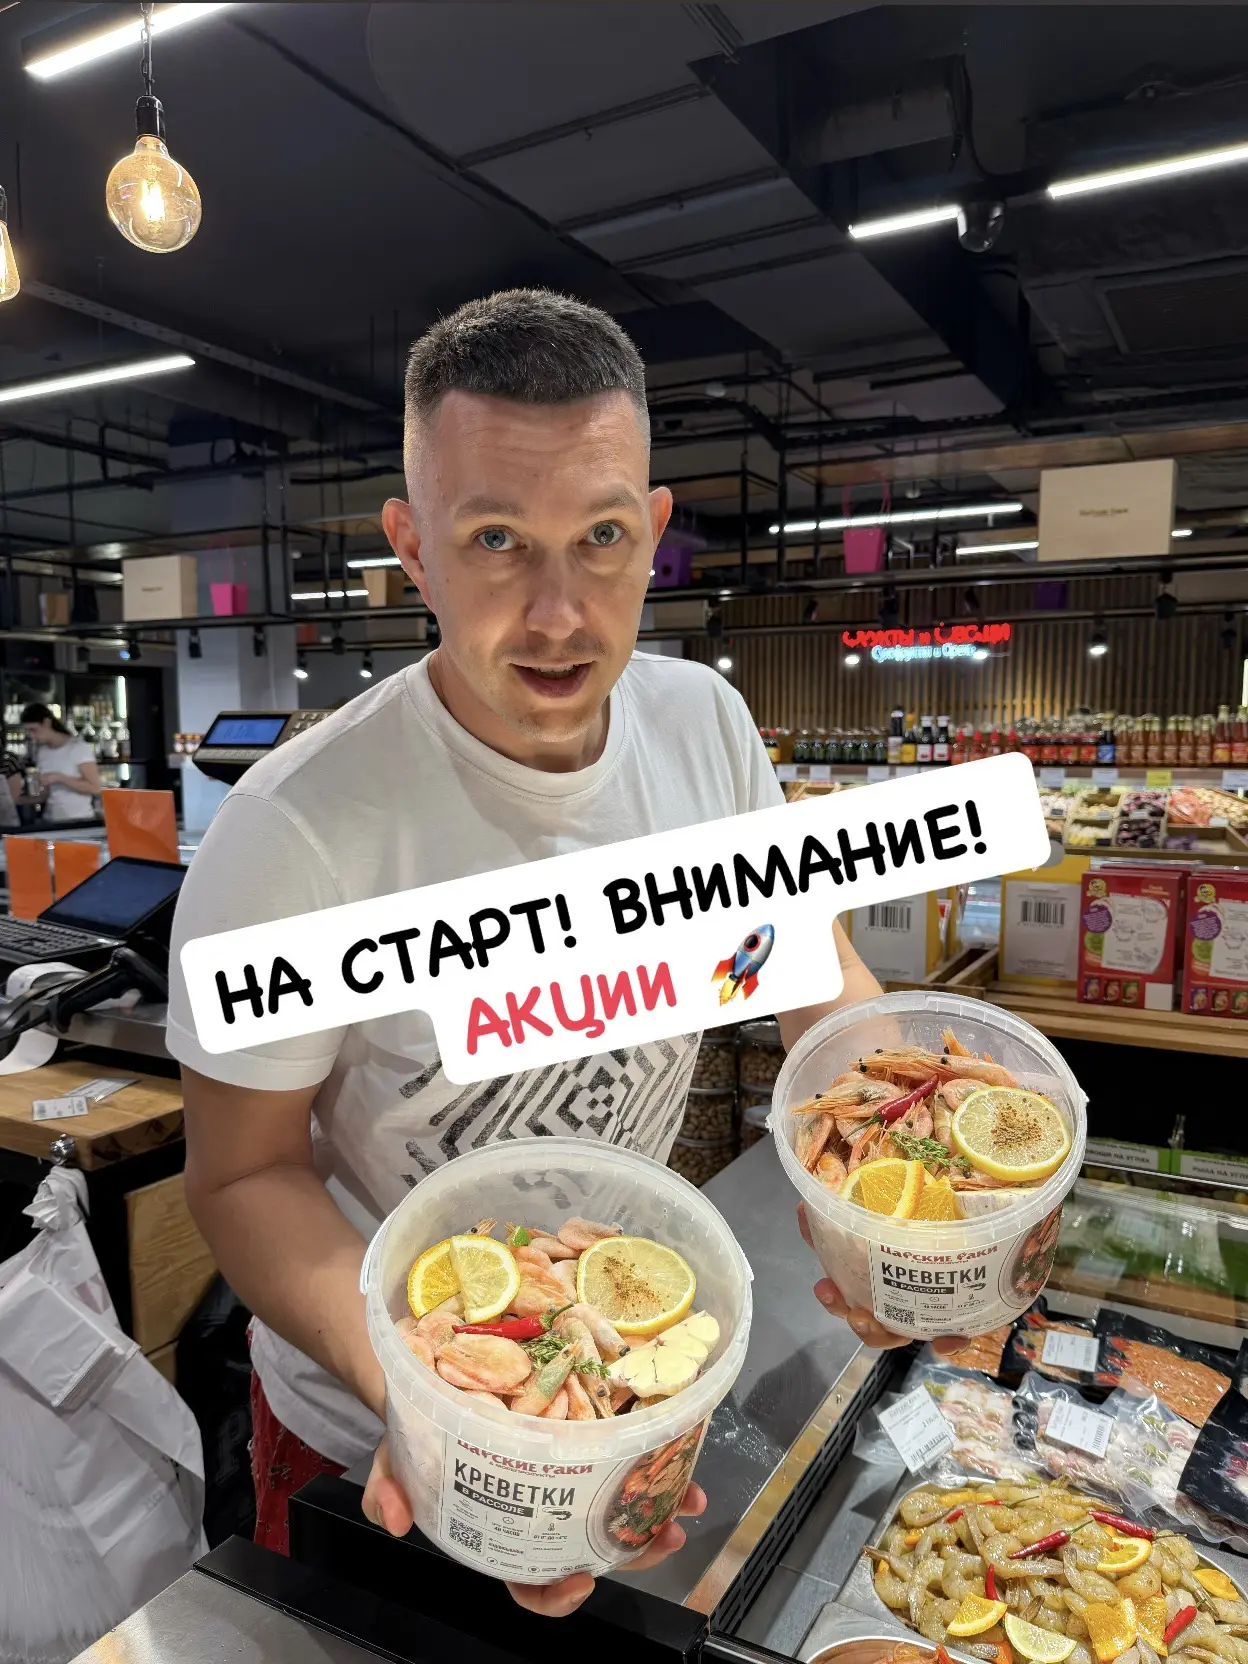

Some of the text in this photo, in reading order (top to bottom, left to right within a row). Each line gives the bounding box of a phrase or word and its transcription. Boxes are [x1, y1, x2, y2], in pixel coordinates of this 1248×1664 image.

[881, 1261, 987, 1285] КРЕВЕТКИ
[900, 1283, 948, 1294] РАССОЛЕ
[454, 1457, 576, 1506] КРЕВЕТКИ
[462, 1486, 469, 1495] В
[472, 1491, 525, 1515] РАССОЛЕ
